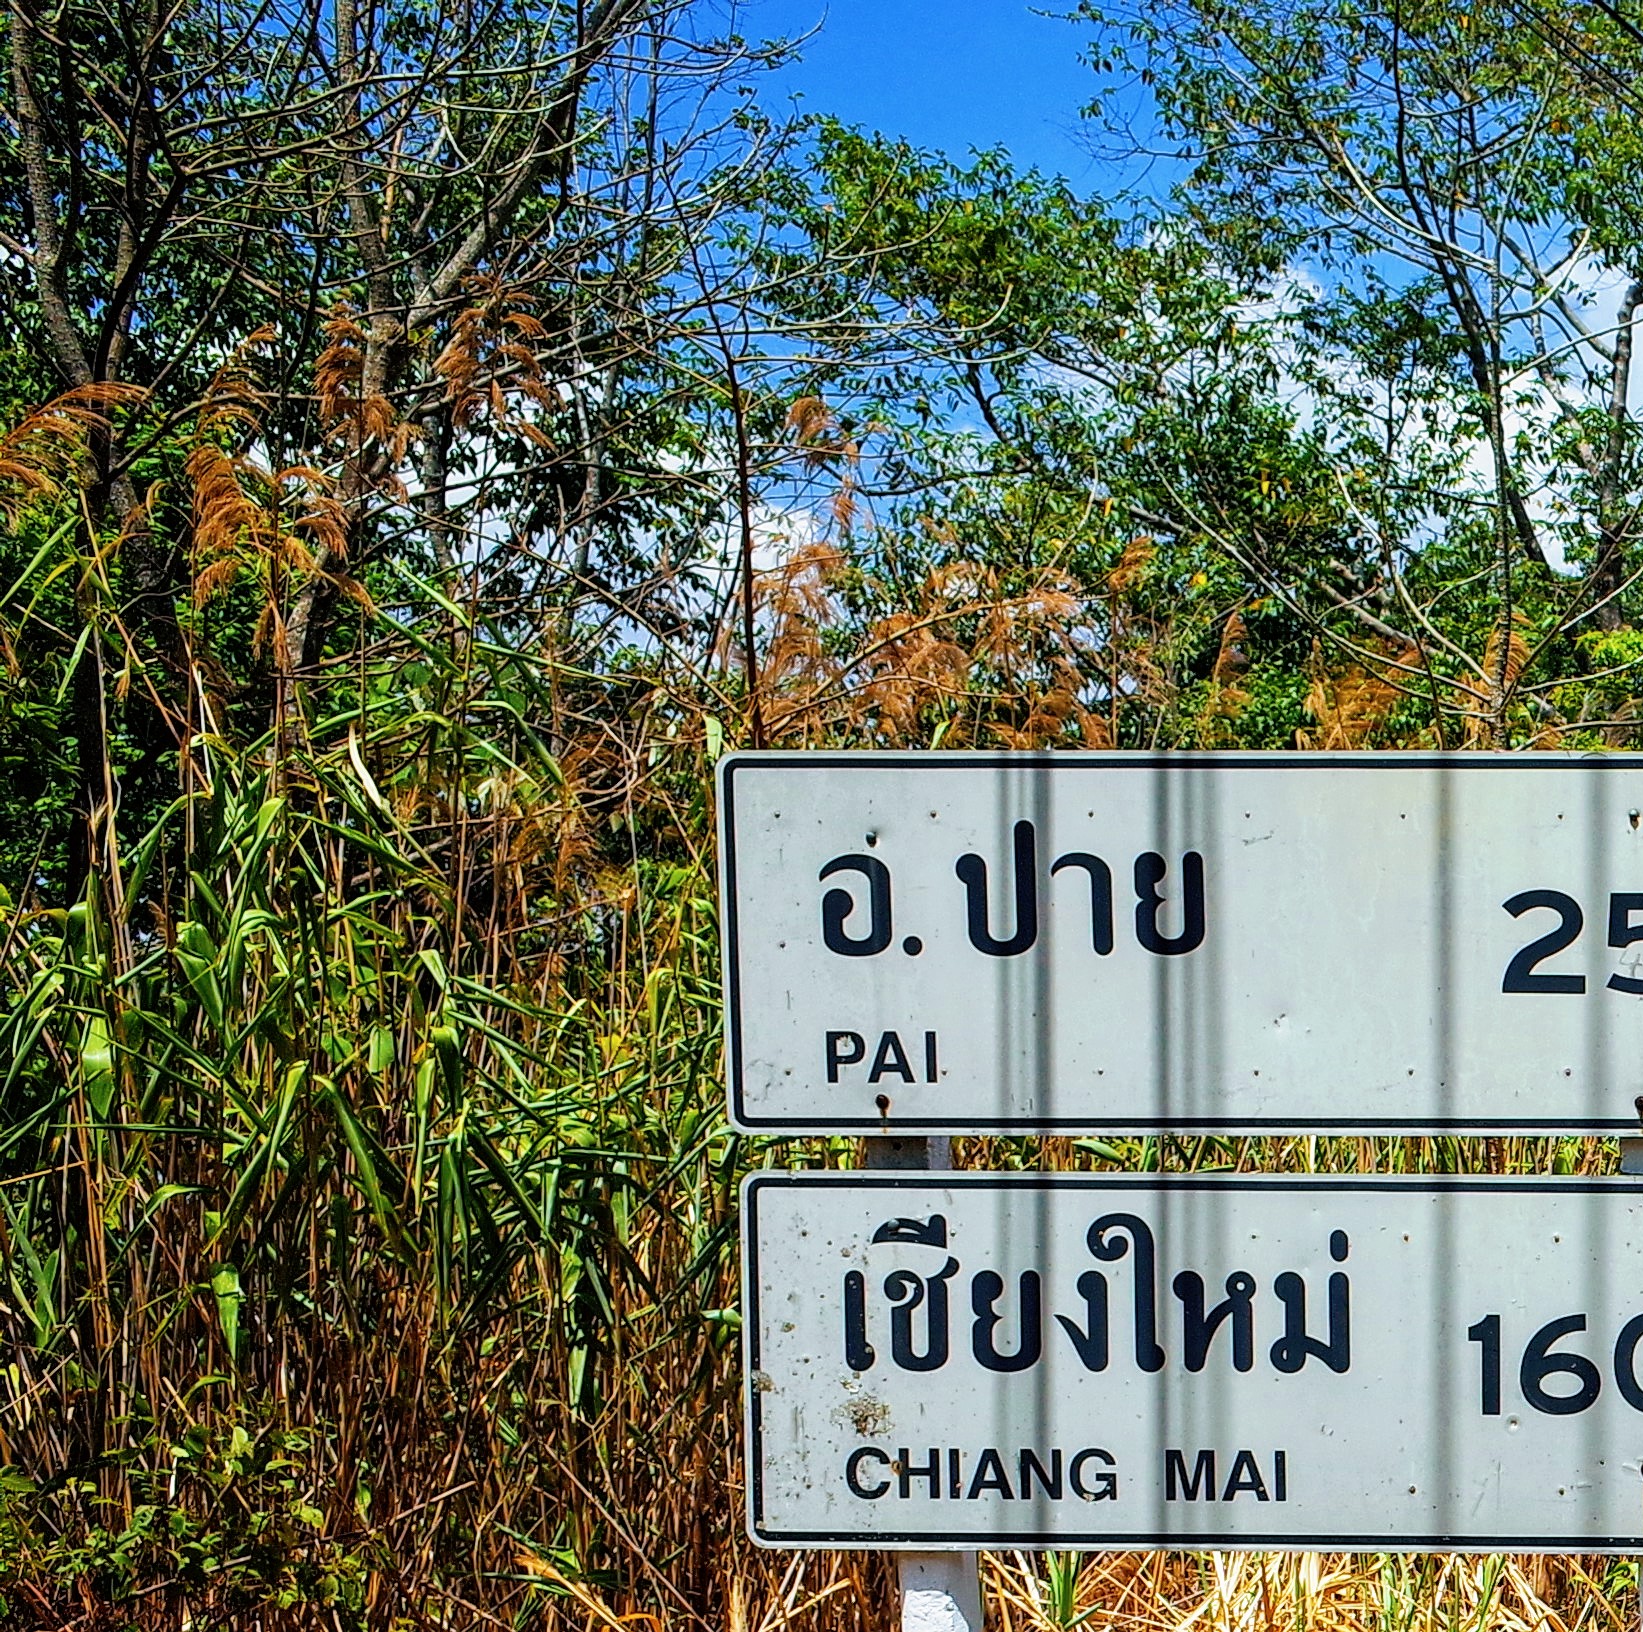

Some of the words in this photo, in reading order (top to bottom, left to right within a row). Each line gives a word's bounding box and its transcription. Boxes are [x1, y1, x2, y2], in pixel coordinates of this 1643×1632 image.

[826, 1031, 939, 1084] PAI
[843, 1212, 1352, 1374] เชียงใหม่
[845, 1446, 1118, 1502] CHIANG
[1165, 1449, 1288, 1502] MAI
